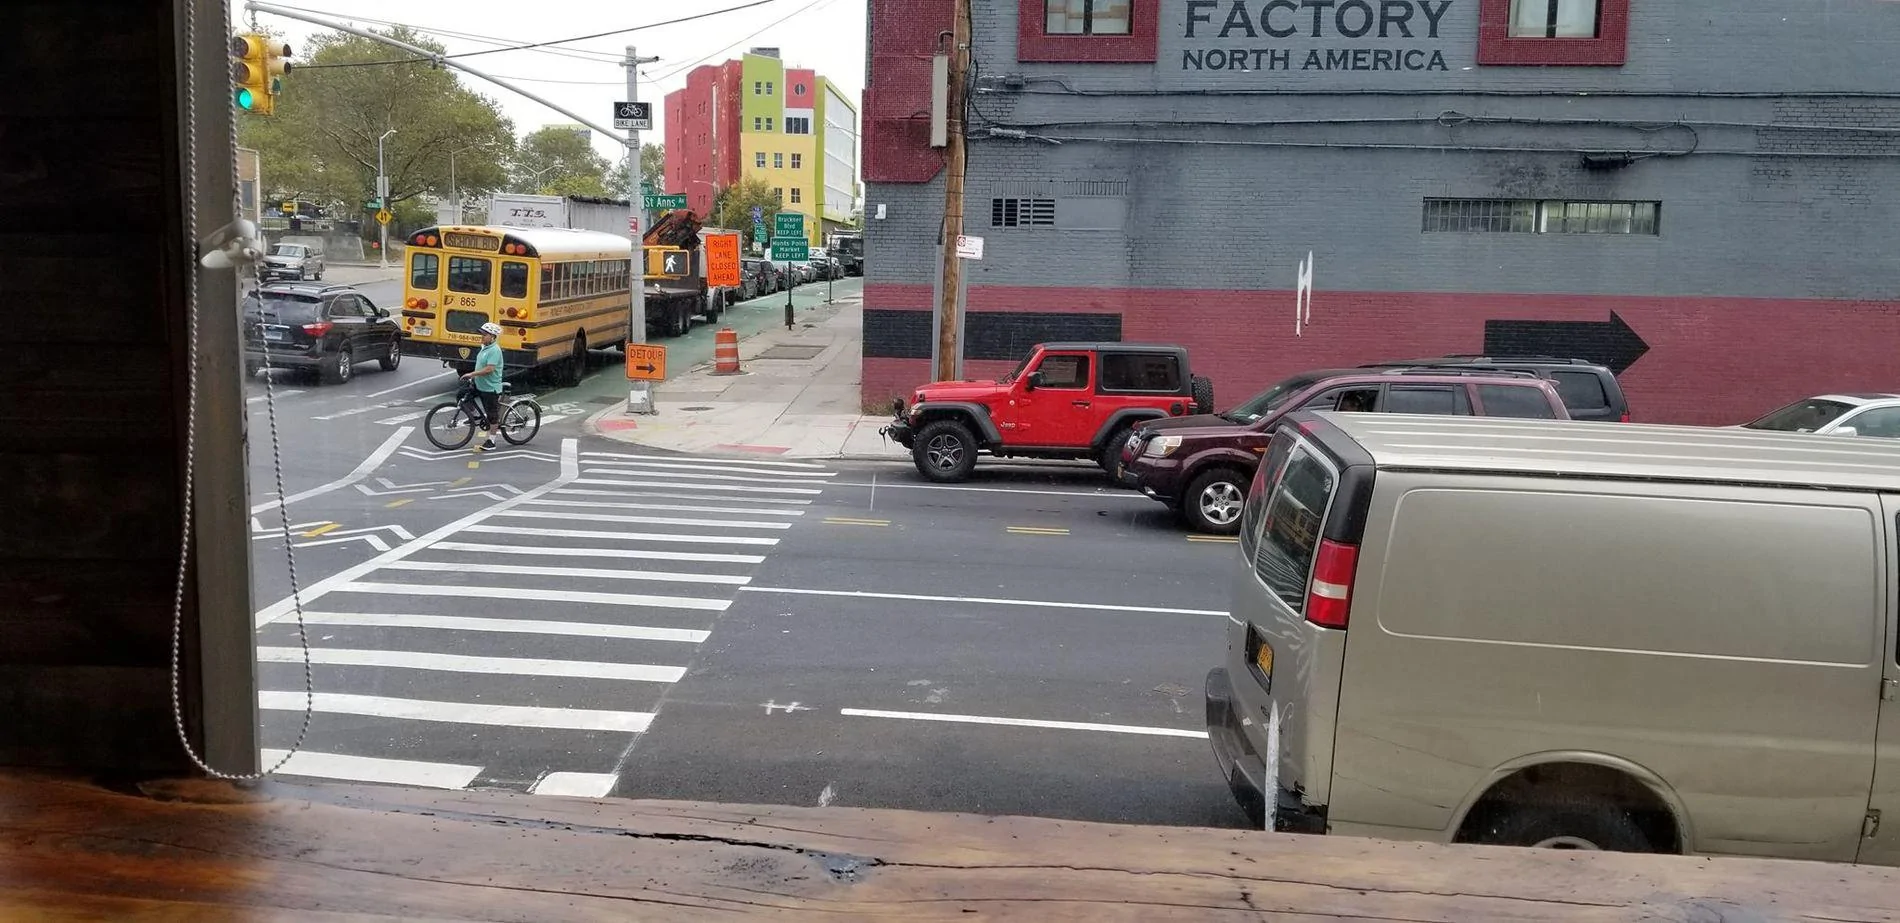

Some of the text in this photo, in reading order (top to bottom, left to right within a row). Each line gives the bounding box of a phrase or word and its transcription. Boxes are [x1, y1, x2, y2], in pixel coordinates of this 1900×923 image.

[1184, 0, 1454, 39] FACTORY
[1182, 48, 1450, 72] NORTH AMERICA
[615, 120, 648, 128] BIKE LANE
[645, 197, 654, 208] St
[656, 197, 676, 208] Anns
[448, 234, 498, 250] SCHOOL BUS
[712, 239, 732, 248] RIGHT
[714, 250, 732, 259] LANE
[710, 262, 736, 270] CLOSED
[713, 273, 735, 281] AHEAD
[460, 296, 477, 307] 865
[630, 348, 664, 361] DETOUR
